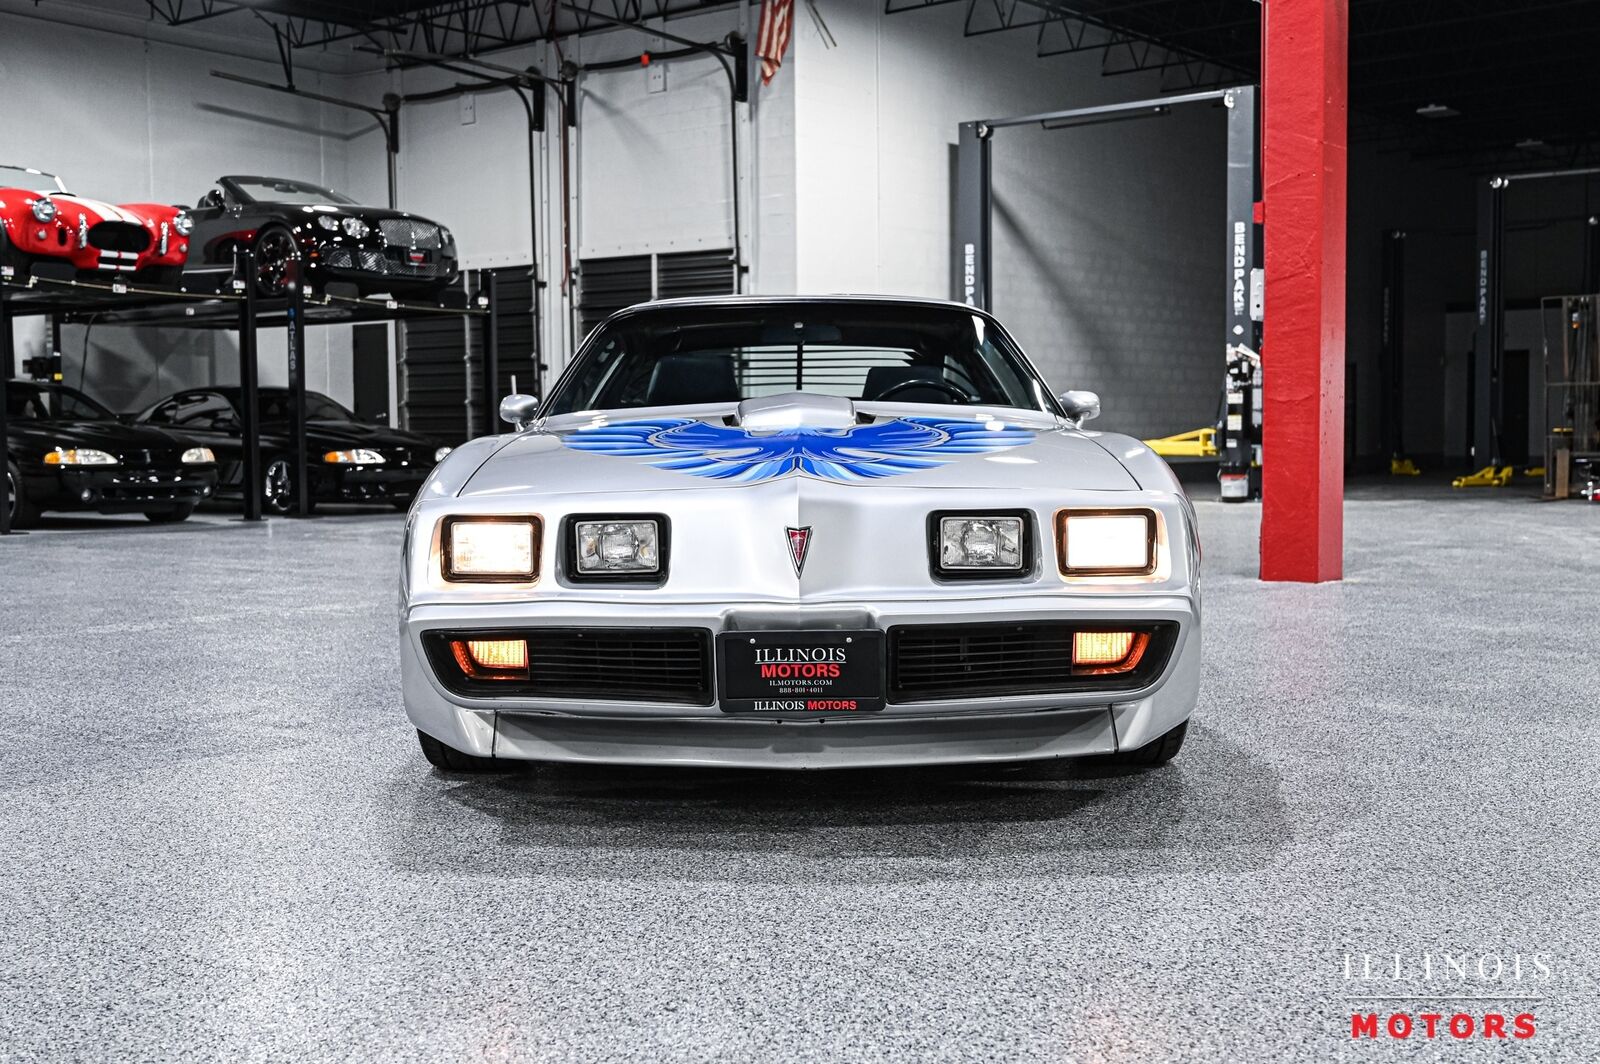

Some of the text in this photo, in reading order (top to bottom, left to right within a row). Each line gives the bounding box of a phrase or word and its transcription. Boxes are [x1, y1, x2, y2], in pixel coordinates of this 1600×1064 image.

[755, 647, 846, 662] ILLINOIS
[761, 664, 841, 678] MOTORS
[754, 701, 857, 711] ILLINOIS MOTORS
